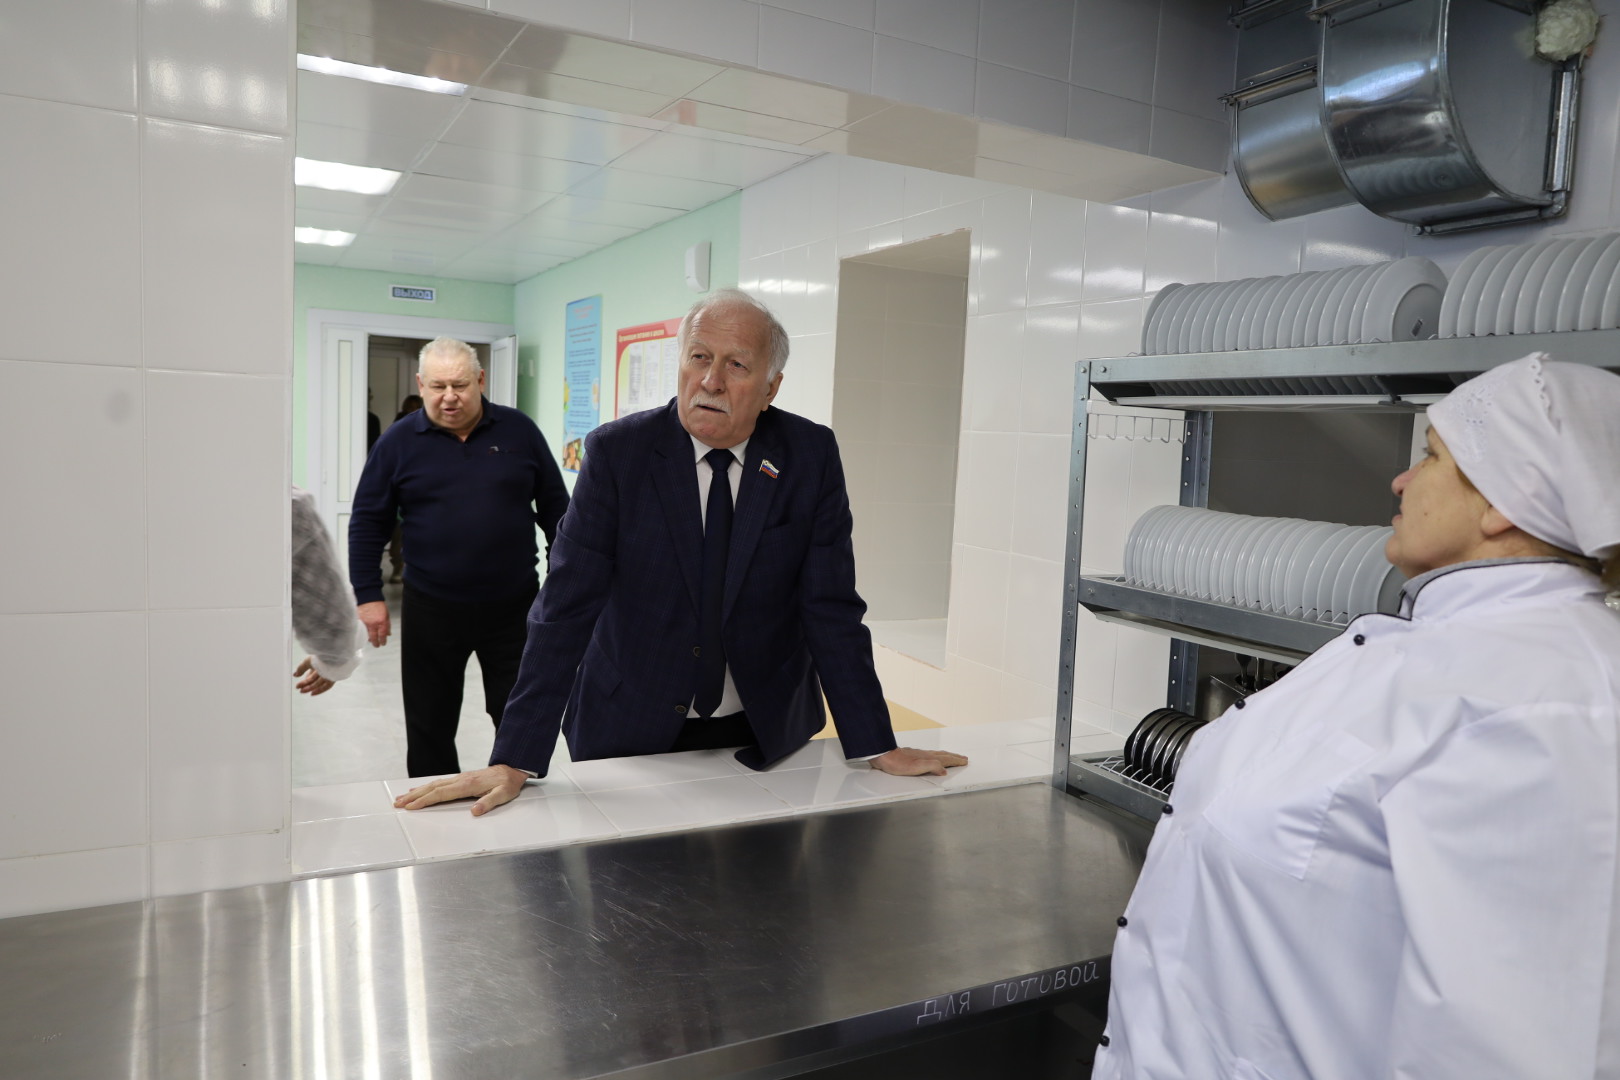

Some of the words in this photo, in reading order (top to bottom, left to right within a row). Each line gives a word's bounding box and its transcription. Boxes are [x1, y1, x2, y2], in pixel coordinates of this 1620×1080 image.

[394, 288, 432, 300] ВЫХОД
[916, 991, 971, 1025] ДЛЯ
[992, 961, 1100, 1007] ГОТОВОЙ
